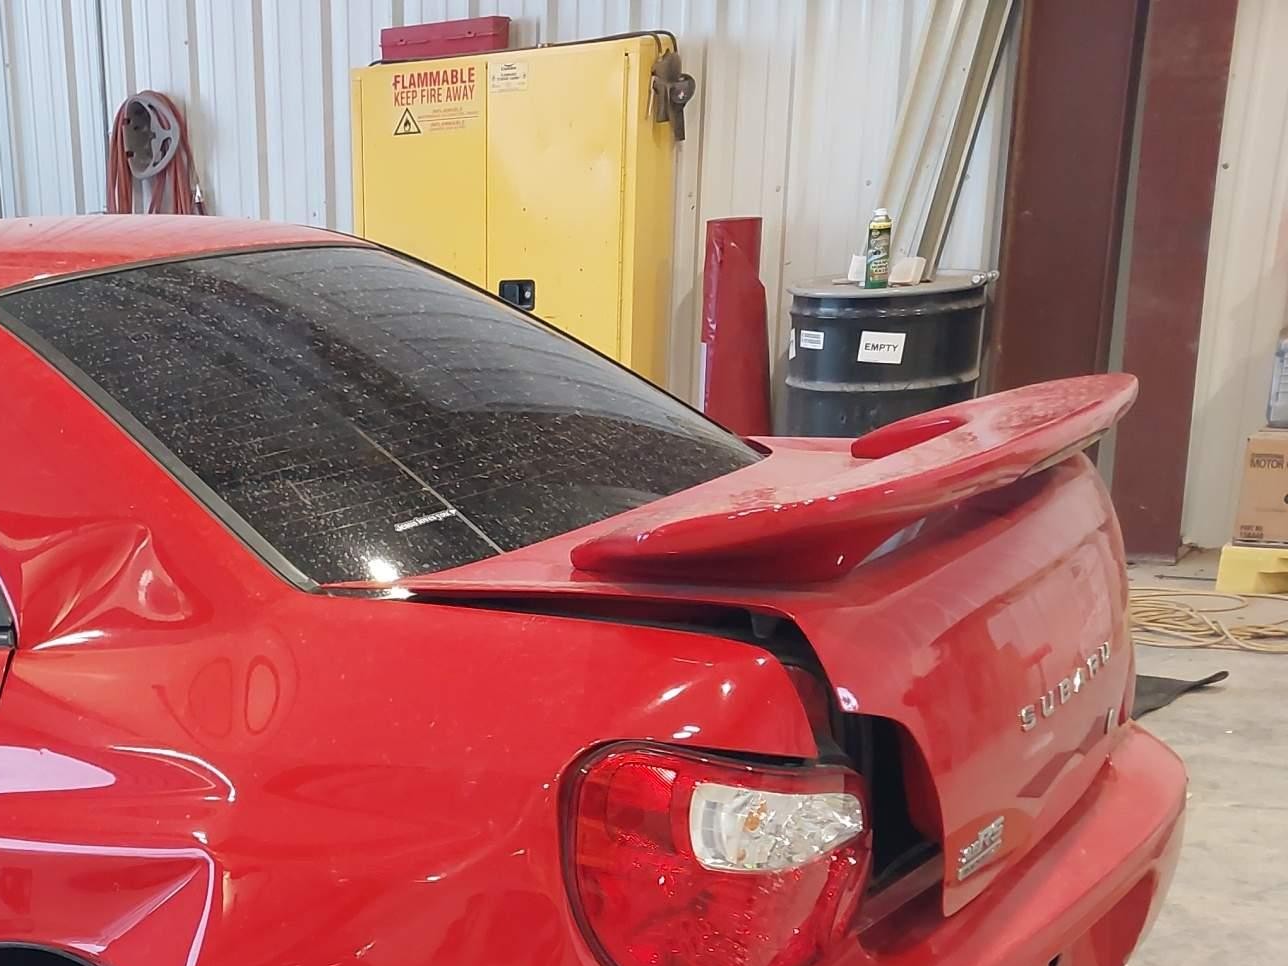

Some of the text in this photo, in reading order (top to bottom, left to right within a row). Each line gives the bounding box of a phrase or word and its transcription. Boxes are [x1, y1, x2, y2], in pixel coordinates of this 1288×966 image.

[393, 67, 475, 90] FLAMMABLE
[394, 84, 475, 107] KEEP FIRE AWAY
[864, 342, 899, 352] EMPTY
[1250, 457, 1284, 469] MOTOR
[1018, 641, 1110, 732] SUBARU
